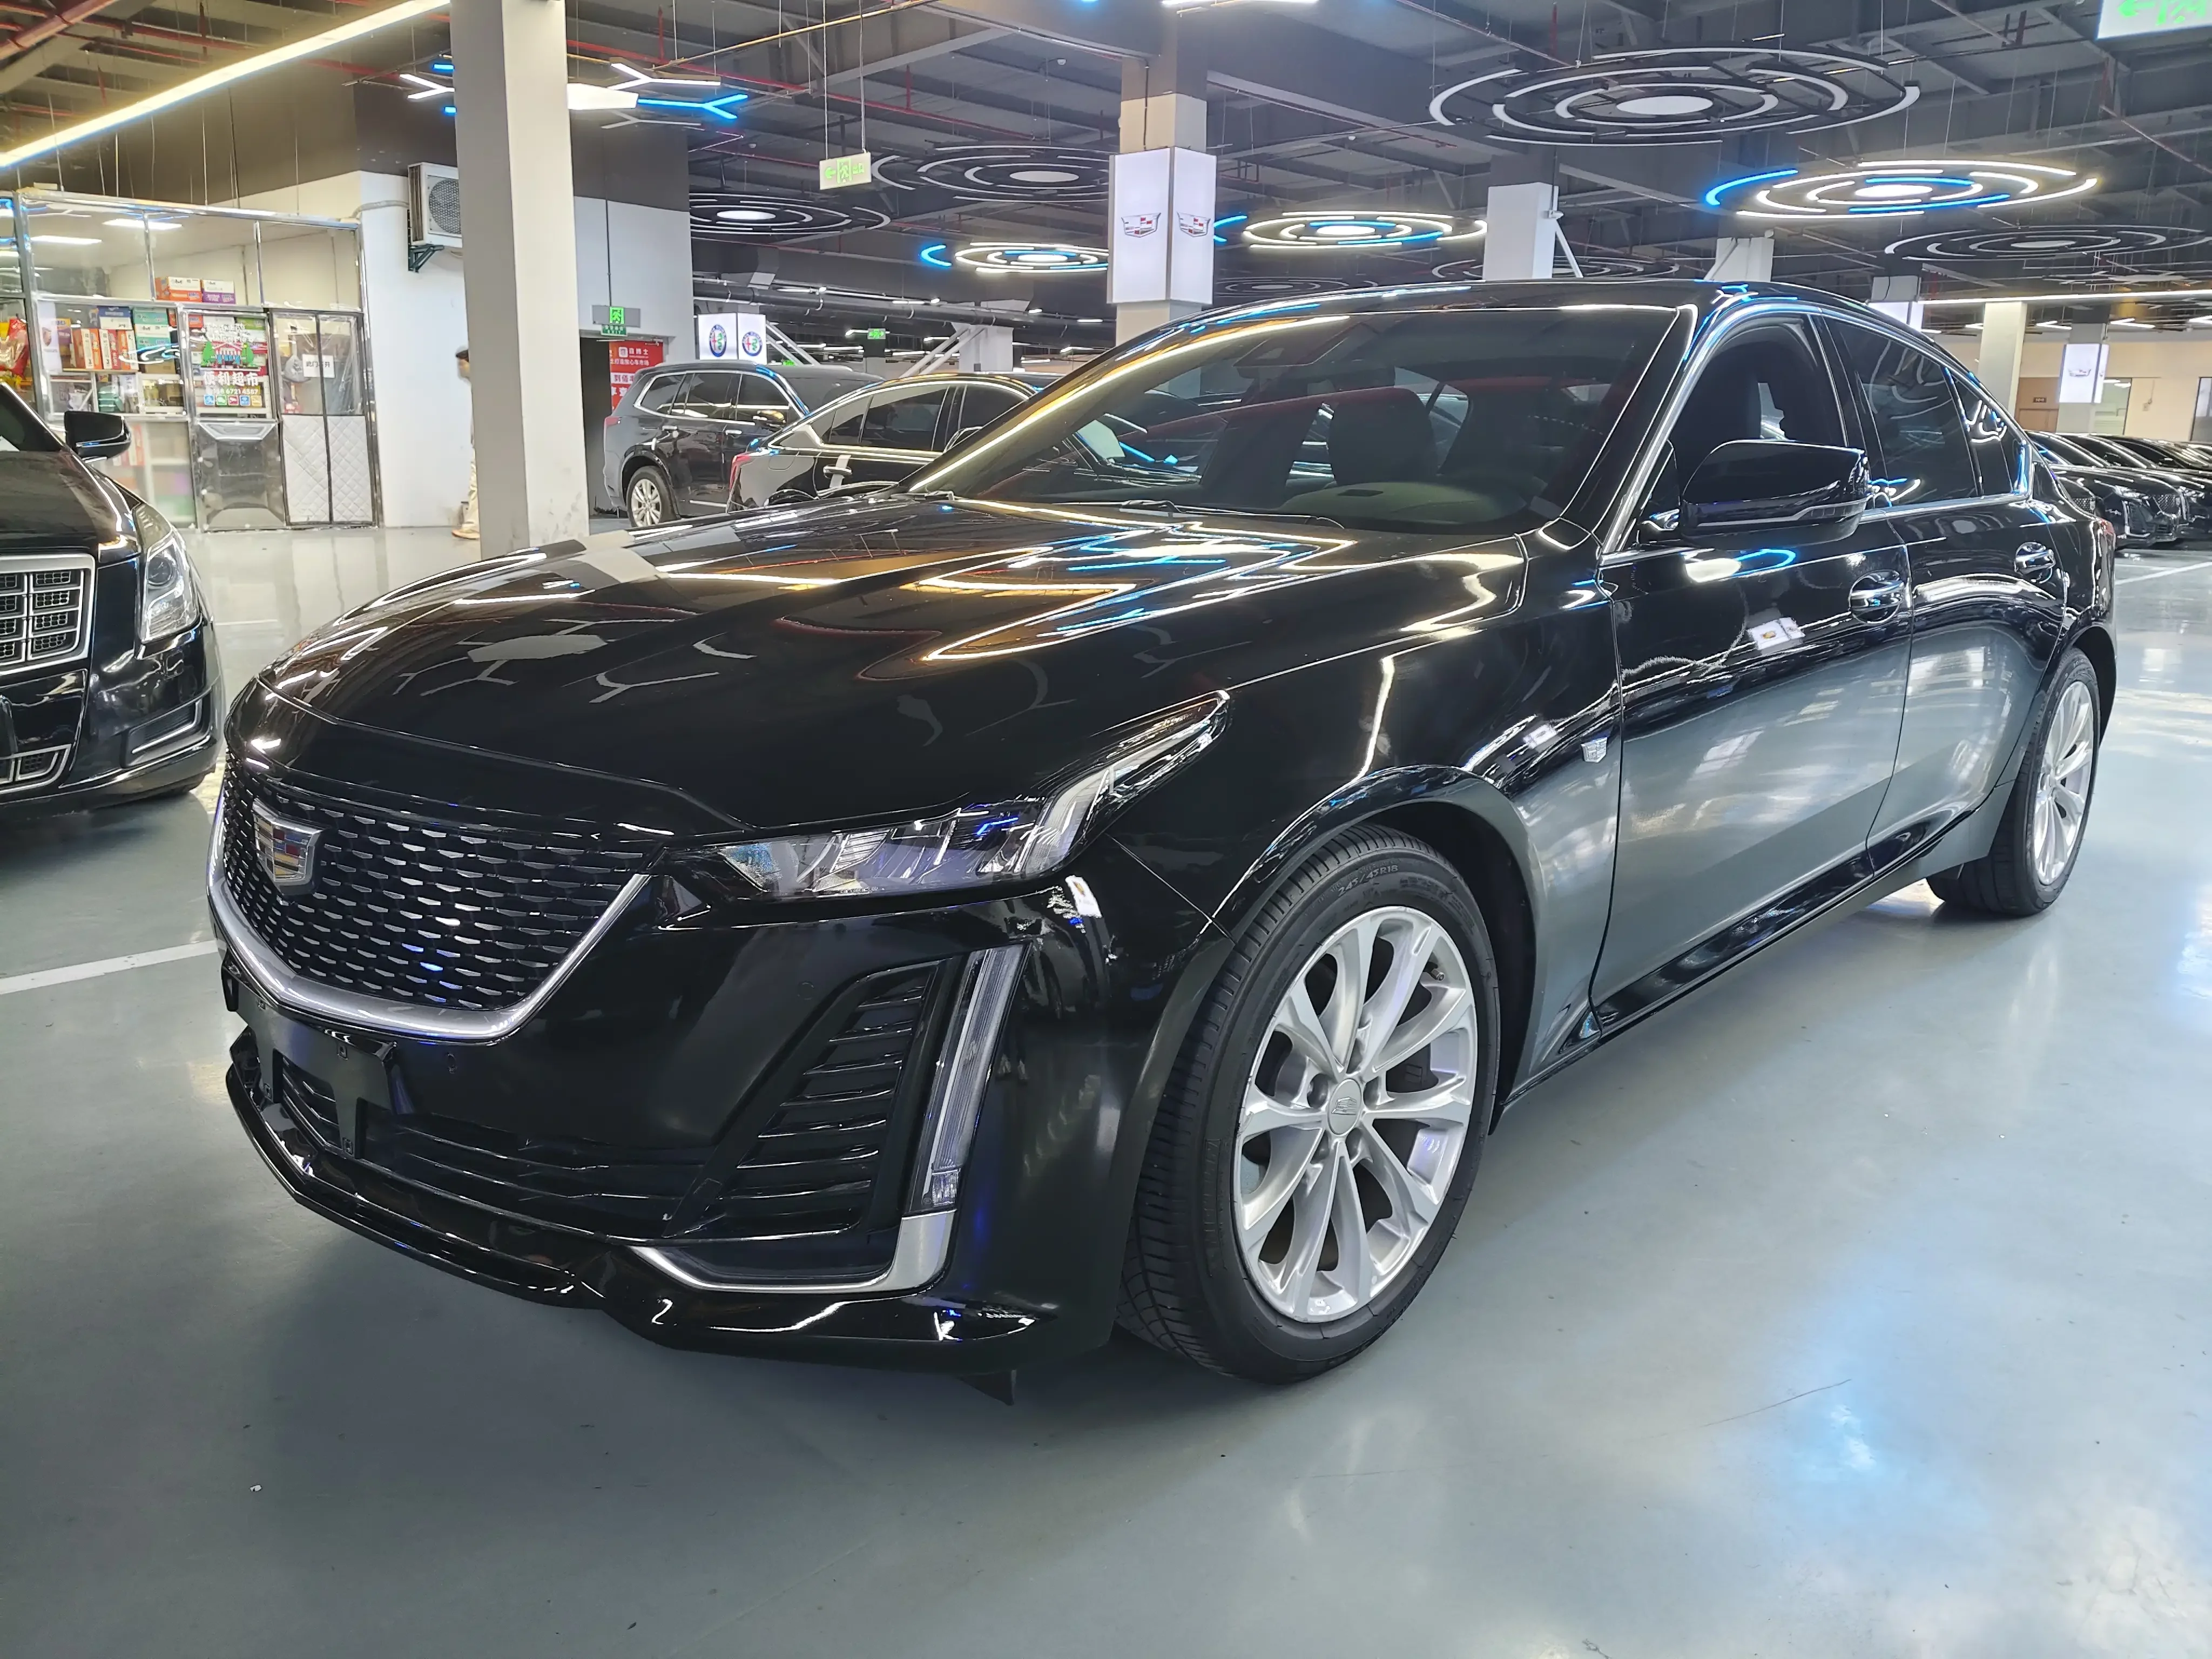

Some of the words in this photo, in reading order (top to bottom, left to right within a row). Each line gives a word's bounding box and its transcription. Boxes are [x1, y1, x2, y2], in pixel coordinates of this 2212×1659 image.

[204, 371, 259, 386] 便利超市
[1338, 865, 1399, 897] 245/45R18
